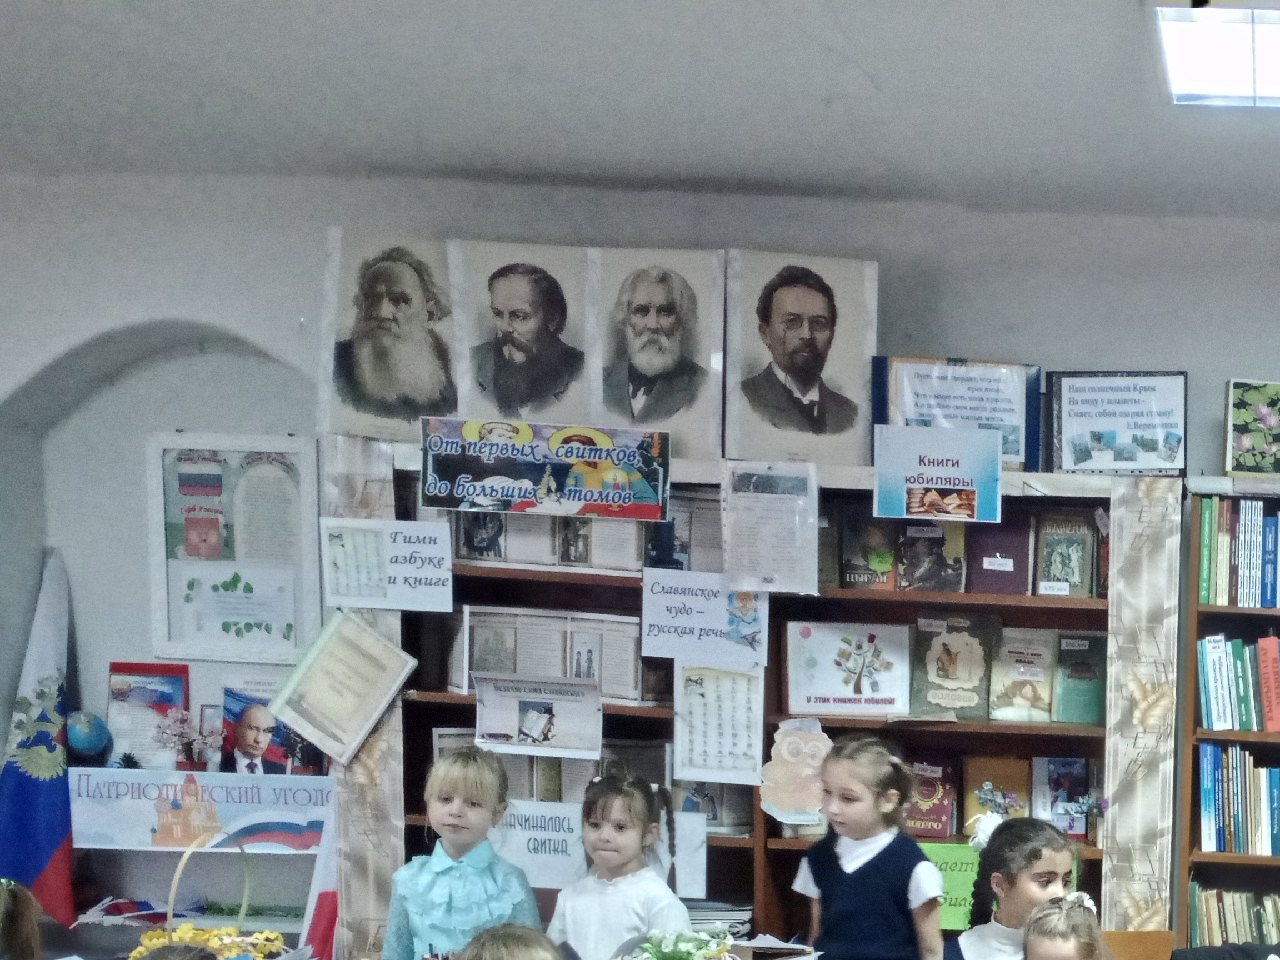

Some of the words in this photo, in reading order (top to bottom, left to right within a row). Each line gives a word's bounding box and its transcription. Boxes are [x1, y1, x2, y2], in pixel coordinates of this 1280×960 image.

[427, 434, 460, 455] От
[465, 441, 541, 463] первых
[555, 446, 642, 465] свитков,
[918, 455, 960, 468] Книги
[905, 473, 974, 487] юбиляры
[426, 478, 449, 496] до
[455, 474, 544, 503] больших
[565, 488, 635, 505] томов
[390, 531, 438, 545] Гимн
[390, 551, 445, 569] азбуке
[388, 575, 397, 585] и
[403, 576, 449, 588] книге
[650, 582, 720, 600] Славянское
[666, 602, 693, 618] чудо
[647, 622, 695, 637] русская
[698, 627, 726, 640] речь
[527, 837, 571, 857] СВИТКА.
